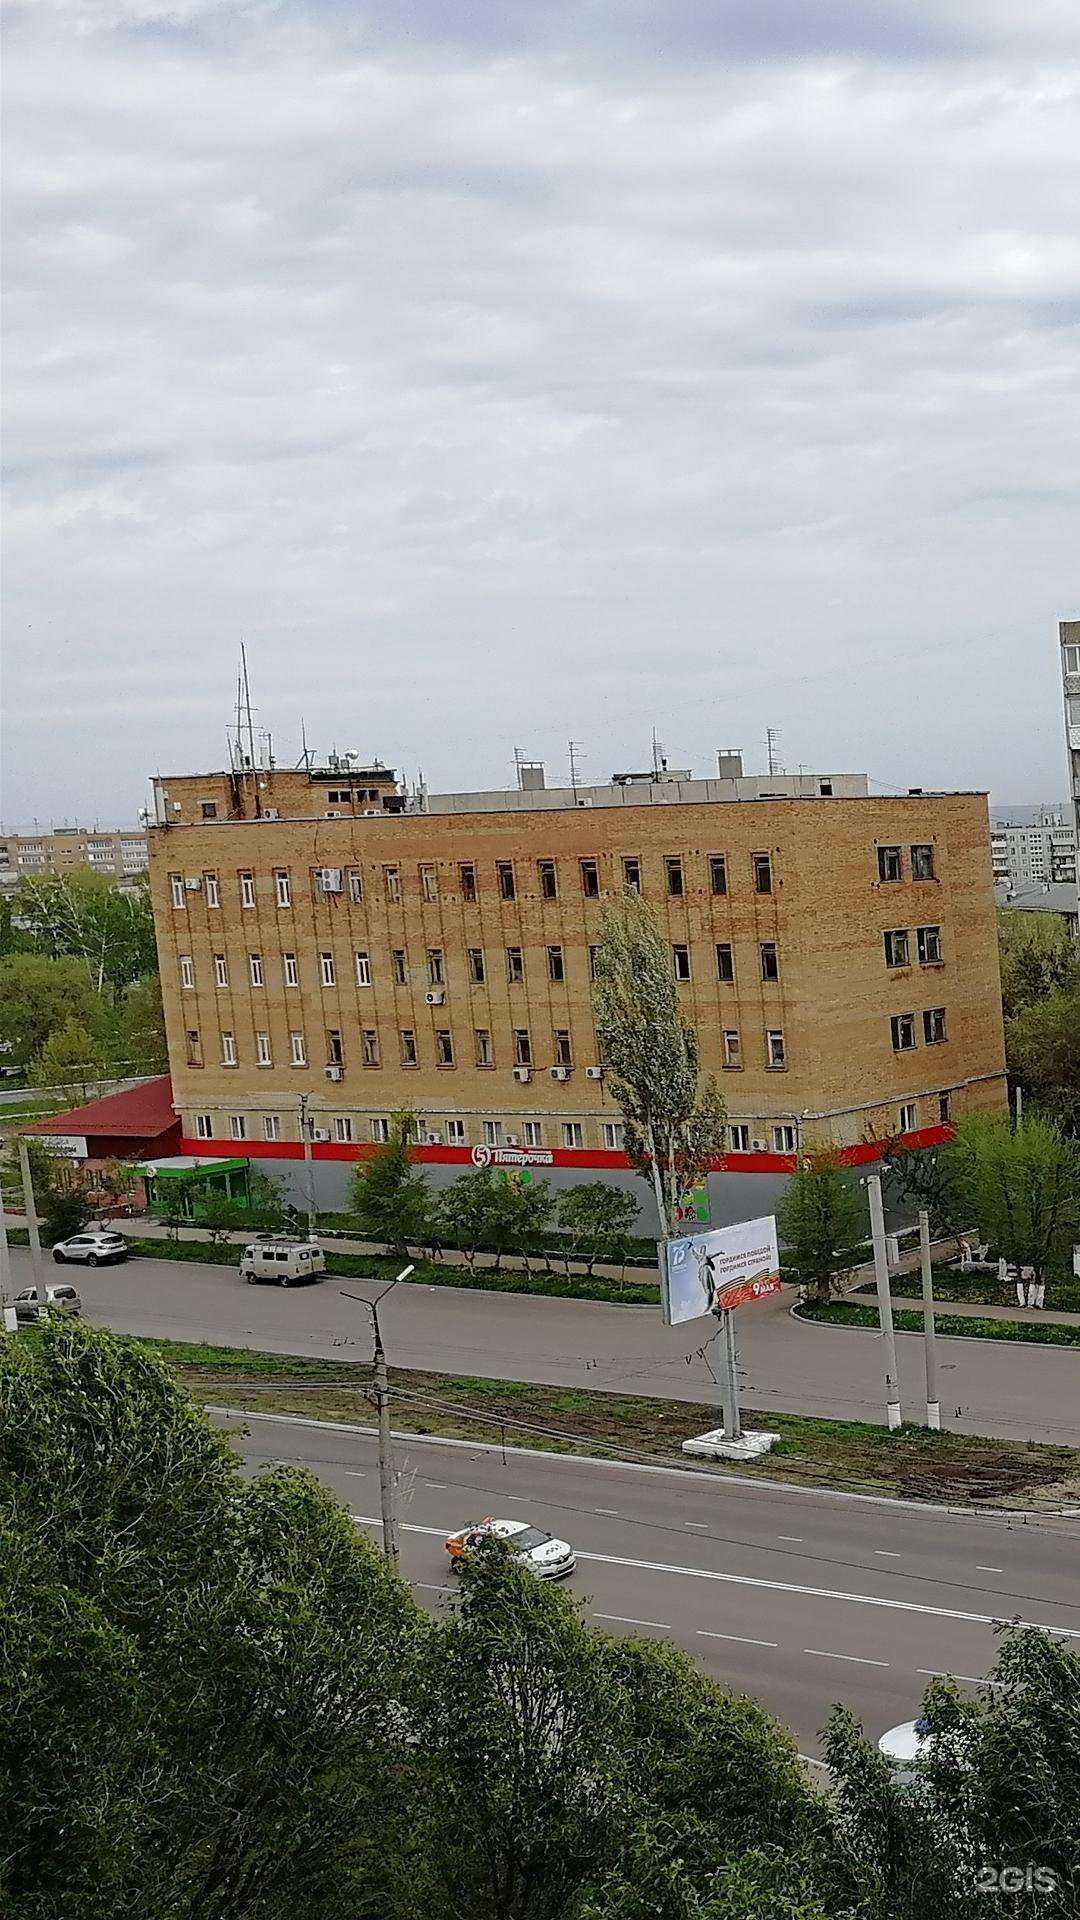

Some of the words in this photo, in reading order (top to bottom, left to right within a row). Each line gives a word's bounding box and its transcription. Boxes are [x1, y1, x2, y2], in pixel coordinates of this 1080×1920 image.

[746, 1245, 771, 1258] ПОБЕДОЙ
[719, 1261, 747, 1274] ГОРДИМСЯ
[752, 1282, 760, 1296] 9
